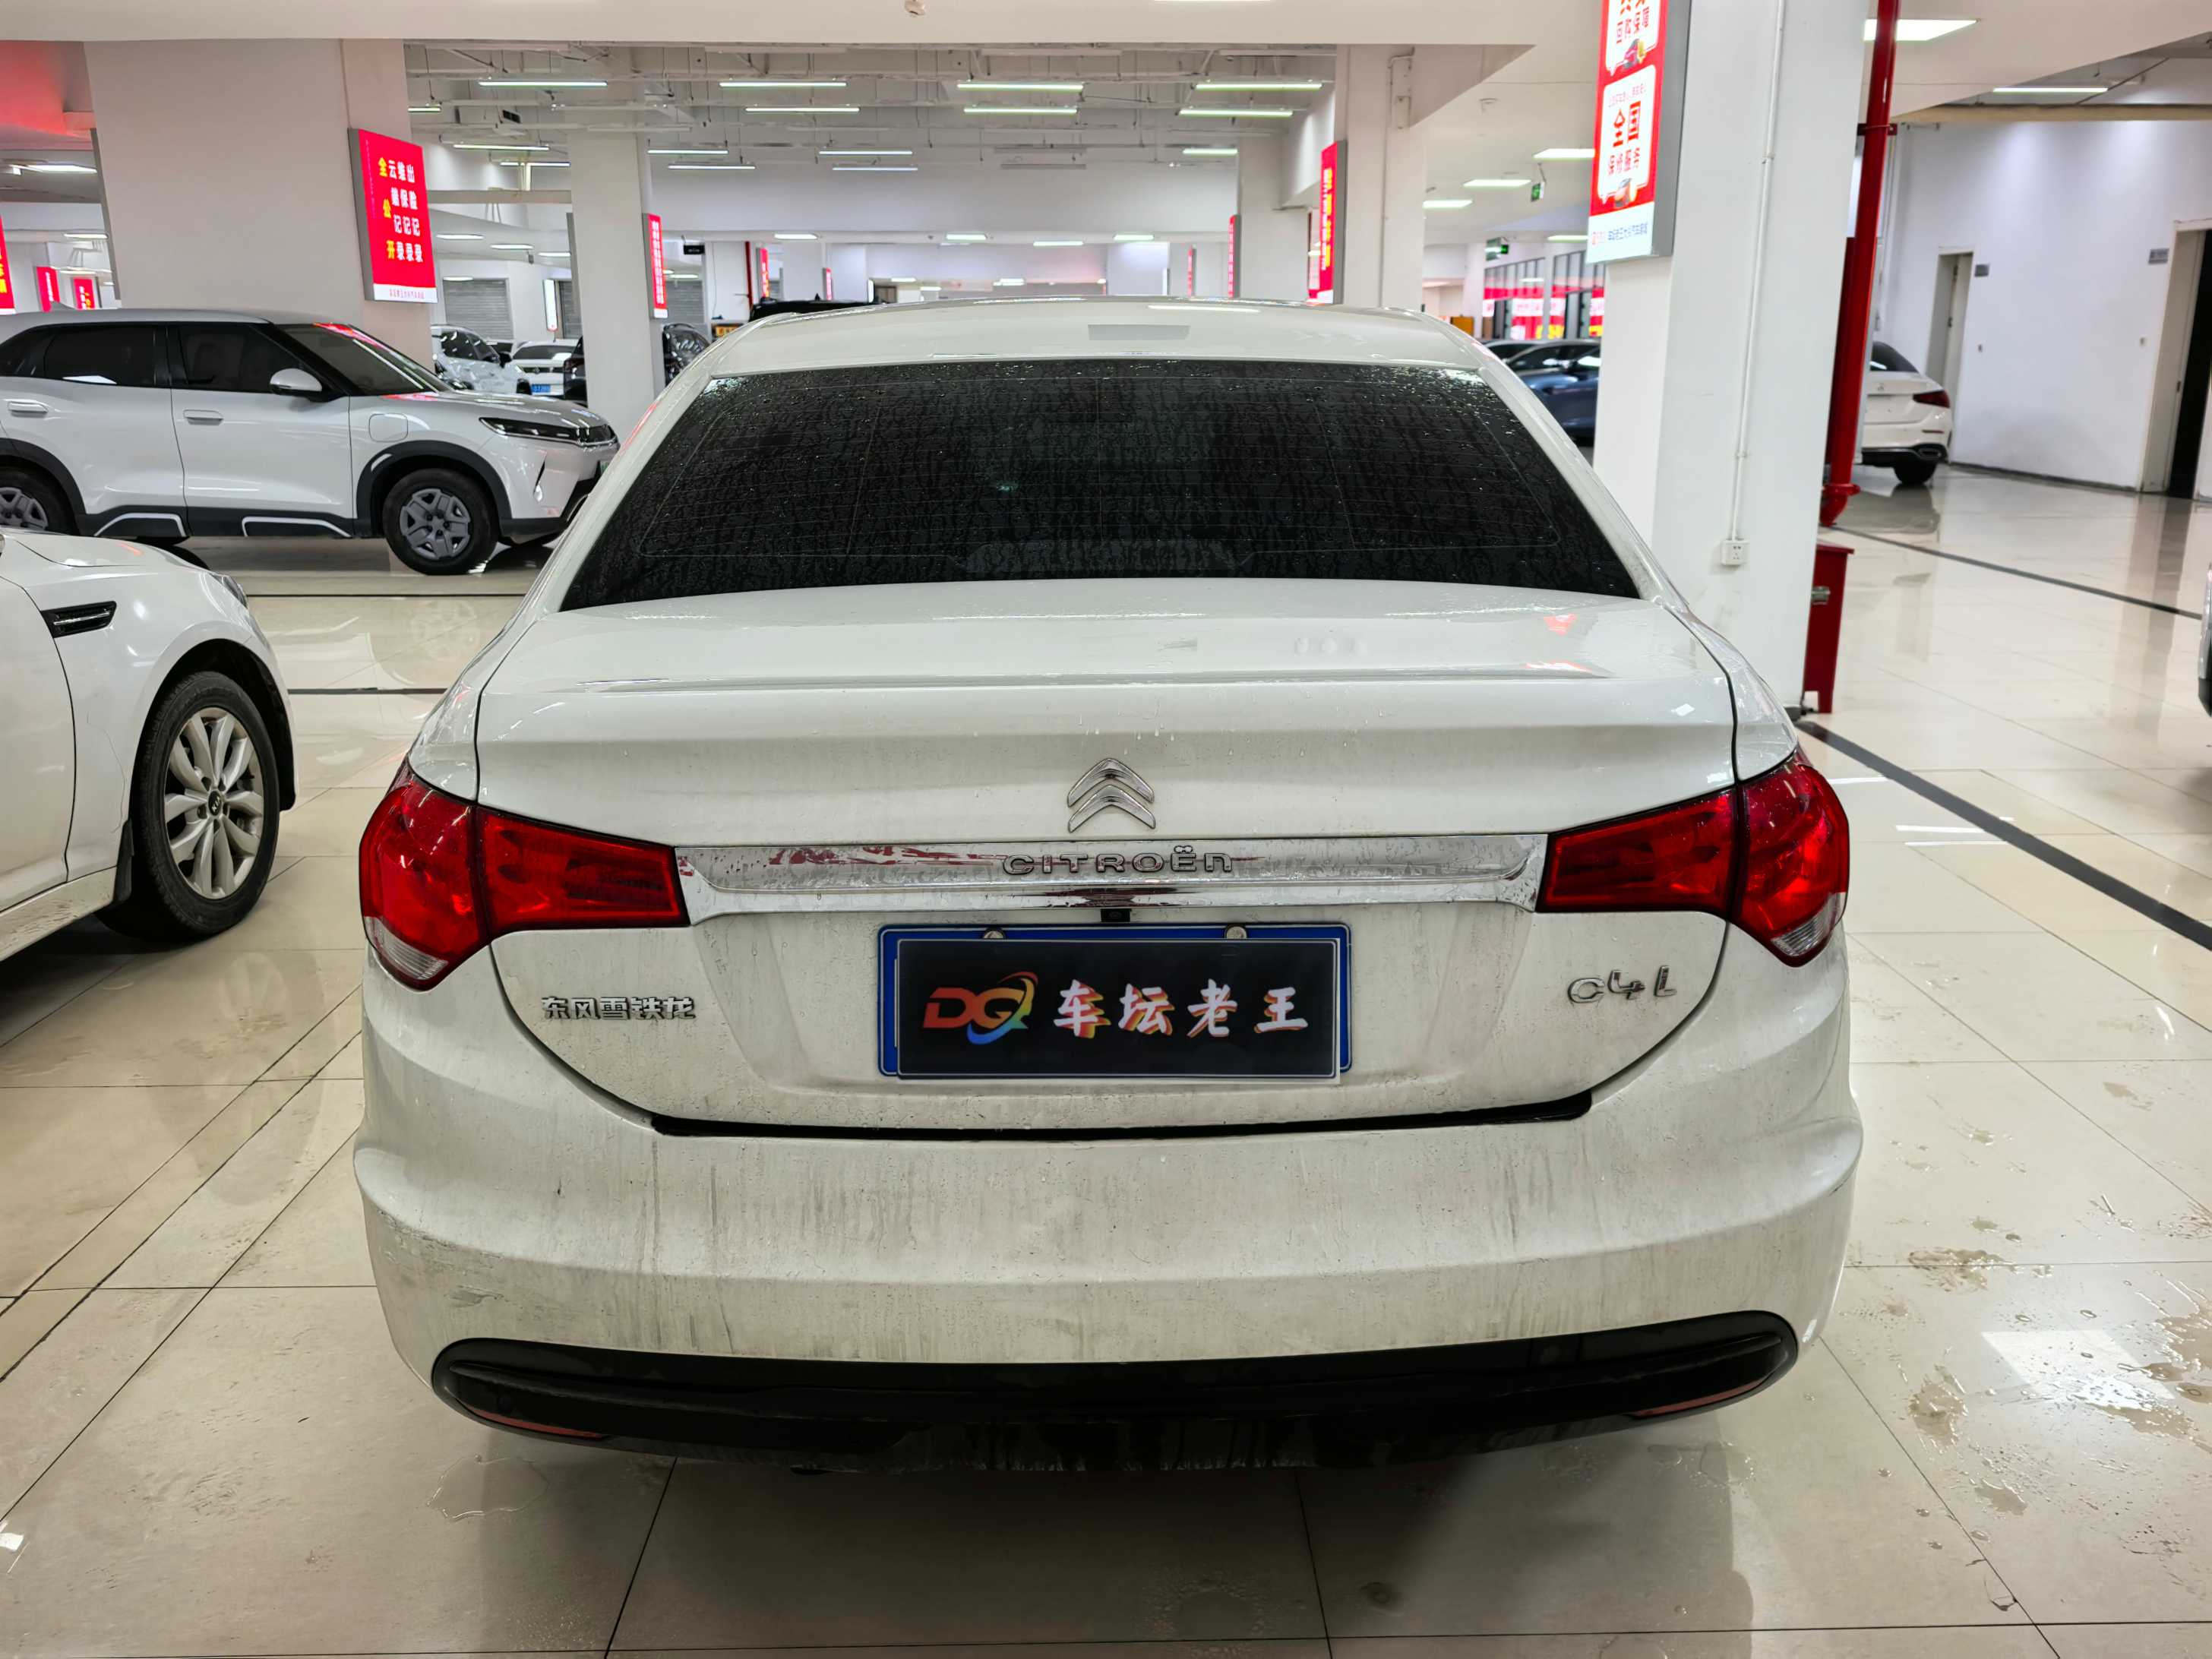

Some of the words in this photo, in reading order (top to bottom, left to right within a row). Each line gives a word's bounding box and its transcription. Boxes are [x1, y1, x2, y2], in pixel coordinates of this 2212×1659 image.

[1613, 100, 1642, 147] 全国
[540, 996, 697, 1020] 东风雪铁龙
[1054, 978, 1309, 1038] 车坛老王
